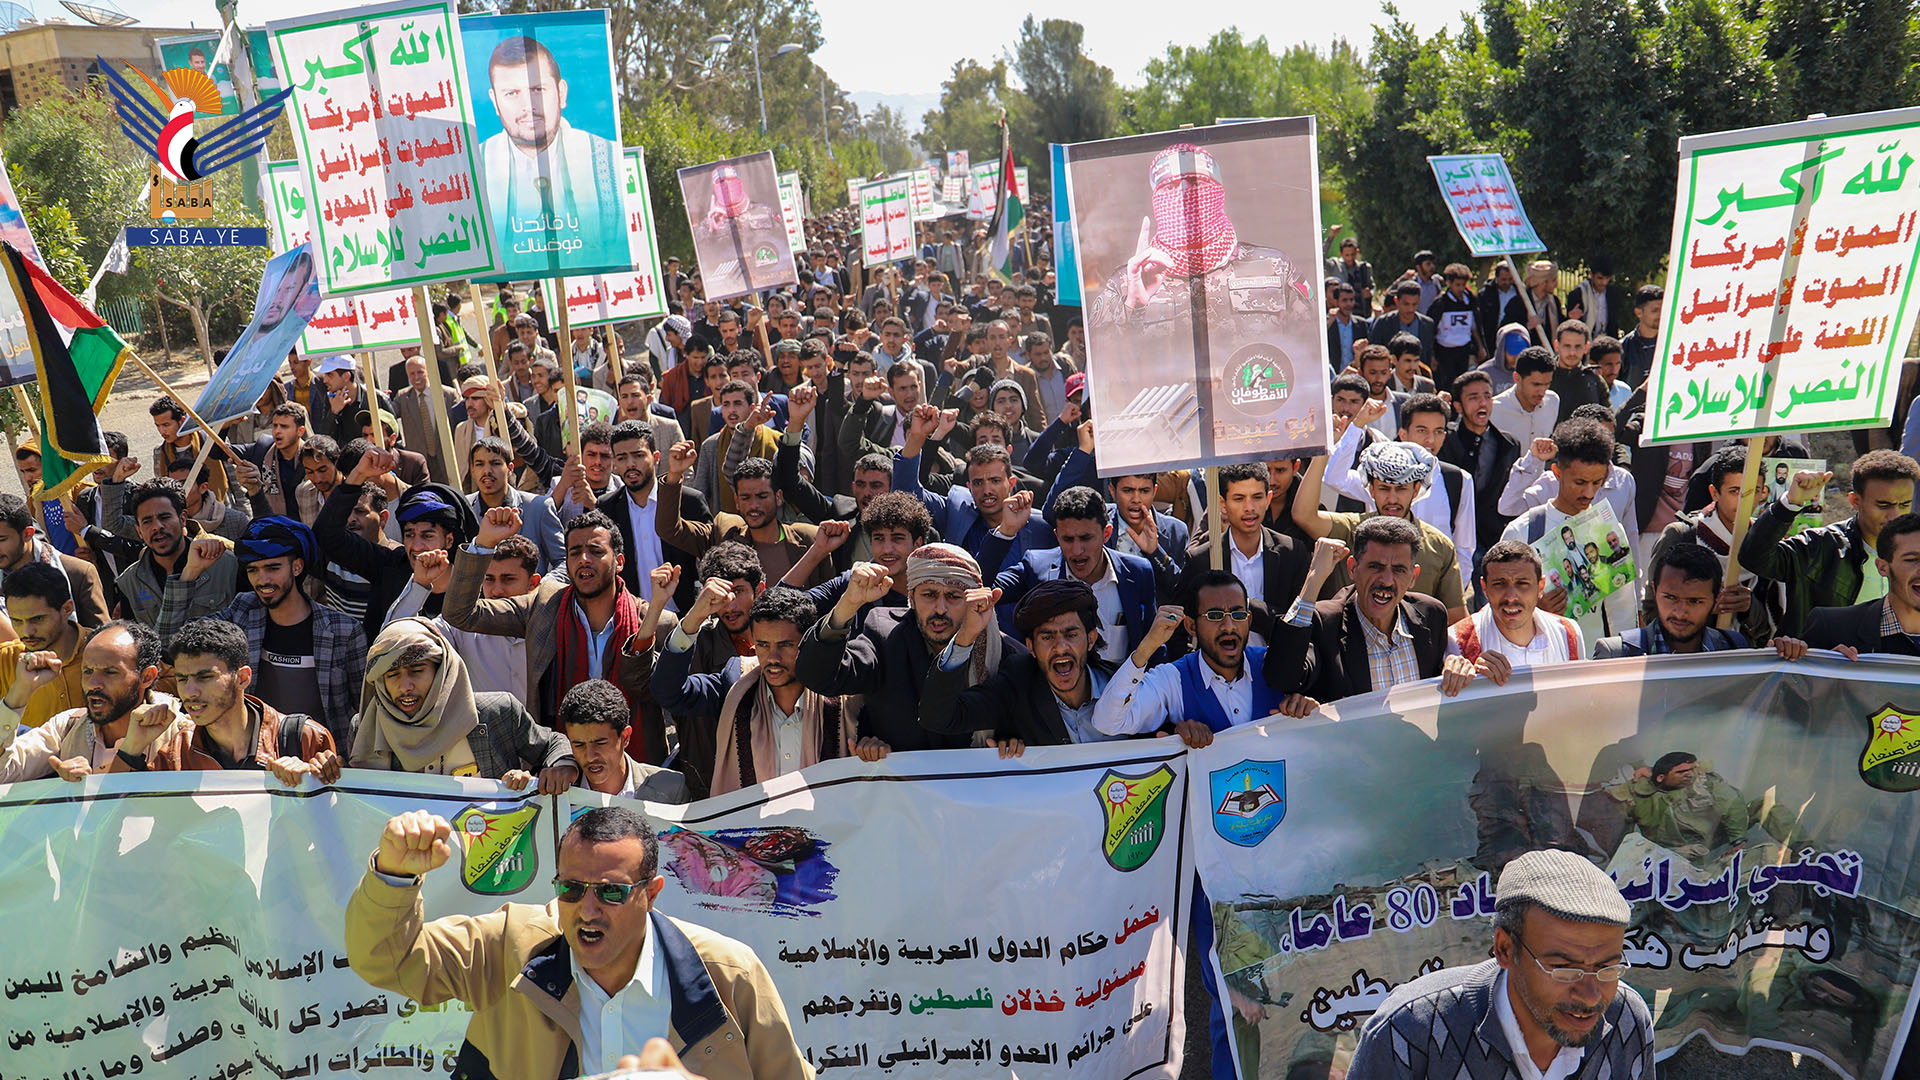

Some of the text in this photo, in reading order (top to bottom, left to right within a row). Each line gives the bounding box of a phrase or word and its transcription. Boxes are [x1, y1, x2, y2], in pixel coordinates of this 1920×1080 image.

[296, 20, 447, 95] الله أكبر
[303, 79, 454, 132] الموت لأمريكا
[317, 125, 462, 182] الموت لإسرائيل
[384, 181, 414, 218] على
[419, 171, 471, 206] اللعنة
[1695, 139, 1919, 230] لله أكبر
[323, 186, 378, 226] اليهود
[511, 211, 580, 233] يا قائدنا
[332, 212, 480, 281] النصر للإسلام
[513, 237, 583, 255] فوضناك
[1690, 210, 1917, 271] الموت لأمريكا
[567, 274, 654, 311] الإسرائيلي
[1681, 263, 1902, 324] الموت لإسرائيل
[1672, 315, 1889, 371] اللعنة على اليهود
[1231, 385, 1269, 398] طوفان
[1665, 359, 1877, 430] النصر للإسلام
[269, 654, 300, 664] FASHION
[1867, 748, 1906, 765] صنعاء
[1132, 784, 1162, 814] جامعة
[494, 820, 528, 850] جامعة
[1109, 815, 1136, 847] صنعاء
[470, 850, 500, 878] صنعاء
[1386, 883, 1439, 932] 80
[180, 926, 241, 958] العظيم
[778, 937, 890, 968] والإسلامية
[898, 936, 979, 965] العربية
[988, 935, 1050, 962] الدول
[1060, 931, 1108, 966] حكام
[4, 970, 64, 1000] لليمن
[71, 943, 173, 996] والشامخ
[802, 960, 1147, 1024] مسئولية خذلان فلسطين وتفرجهم
[45, 995, 165, 1049] والإسلامية
[288, 1003, 322, 1034] كل
[328, 994, 388, 1028] تصدر
[8, 1029, 36, 1051] من
[150, 1020, 224, 1063] وصلت
[803, 1001, 1153, 1075] على جرائم العدو الإسرائيلي النكرا
[100, 1054, 144, 1079] وما
[328, 1042, 435, 1073] والطائرات
